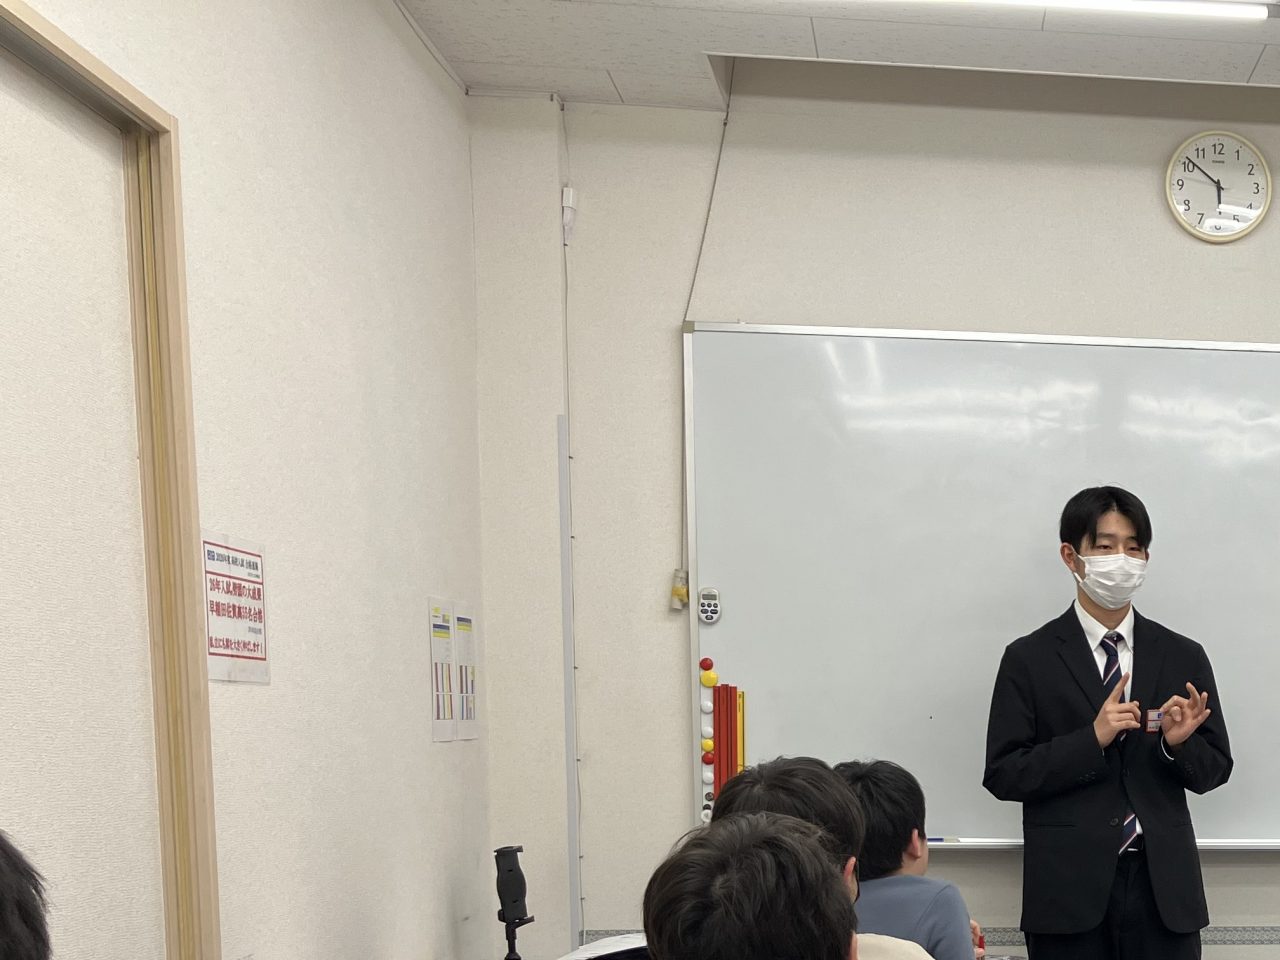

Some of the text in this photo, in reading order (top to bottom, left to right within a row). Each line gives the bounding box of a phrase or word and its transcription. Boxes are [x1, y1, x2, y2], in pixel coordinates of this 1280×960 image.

[1195, 147, 1206, 159] 11
[1212, 143, 1225, 155] 12
[1235, 149, 1240, 161] 1
[1182, 160, 1195, 173] 10
[1247, 163, 1255, 176] 2
[1176, 179, 1184, 190] 9
[1252, 182, 1260, 194] 3
[1183, 199, 1191, 211] 8
[1197, 213, 1205, 224] 7
